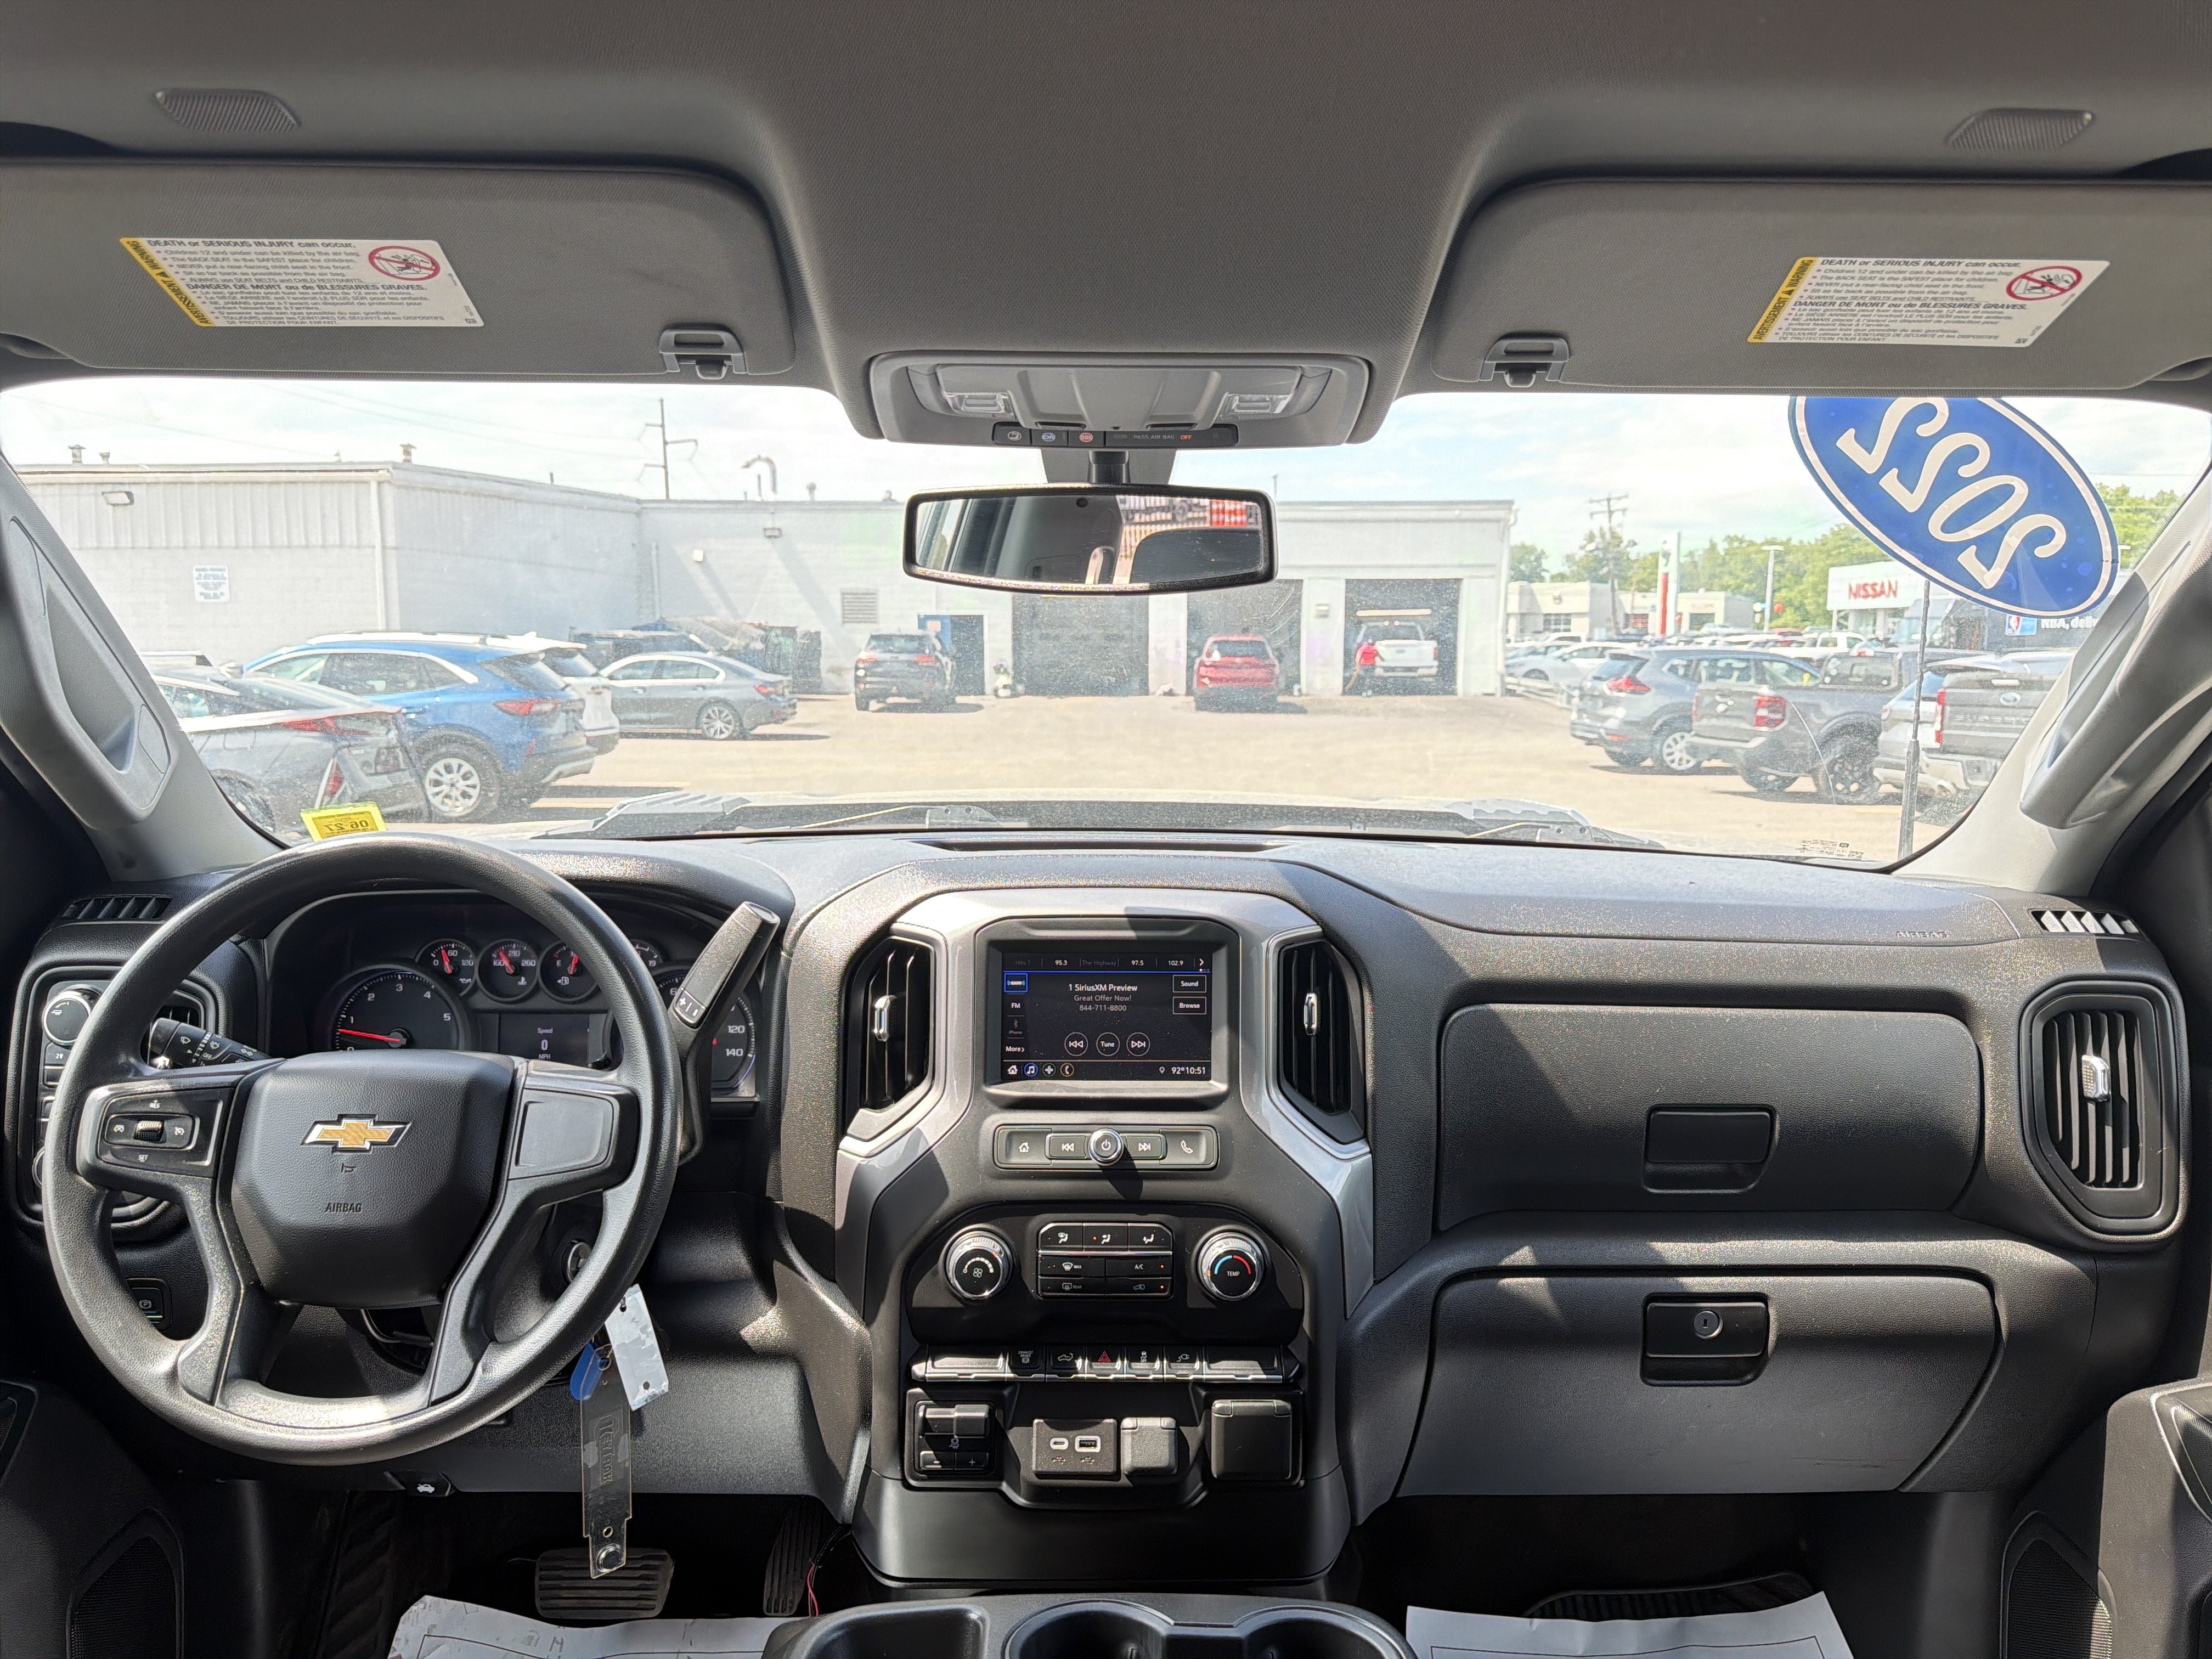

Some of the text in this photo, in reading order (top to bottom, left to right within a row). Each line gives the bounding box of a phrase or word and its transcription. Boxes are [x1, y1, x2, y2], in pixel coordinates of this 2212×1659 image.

[1786, 259, 1813, 288] WARNING
[1753, 297, 1789, 340] AVERTISSEMENT
[1848, 579, 1898, 600] NISSAN
[368, 993, 375, 1001] 2
[424, 991, 431, 999] 4
[443, 1013, 451, 1021] 5
[727, 1025, 745, 1034] 120
[541, 1040, 548, 1051] 0
[725, 1048, 743, 1057] 140
[325, 1203, 362, 1212] AIRBAG
